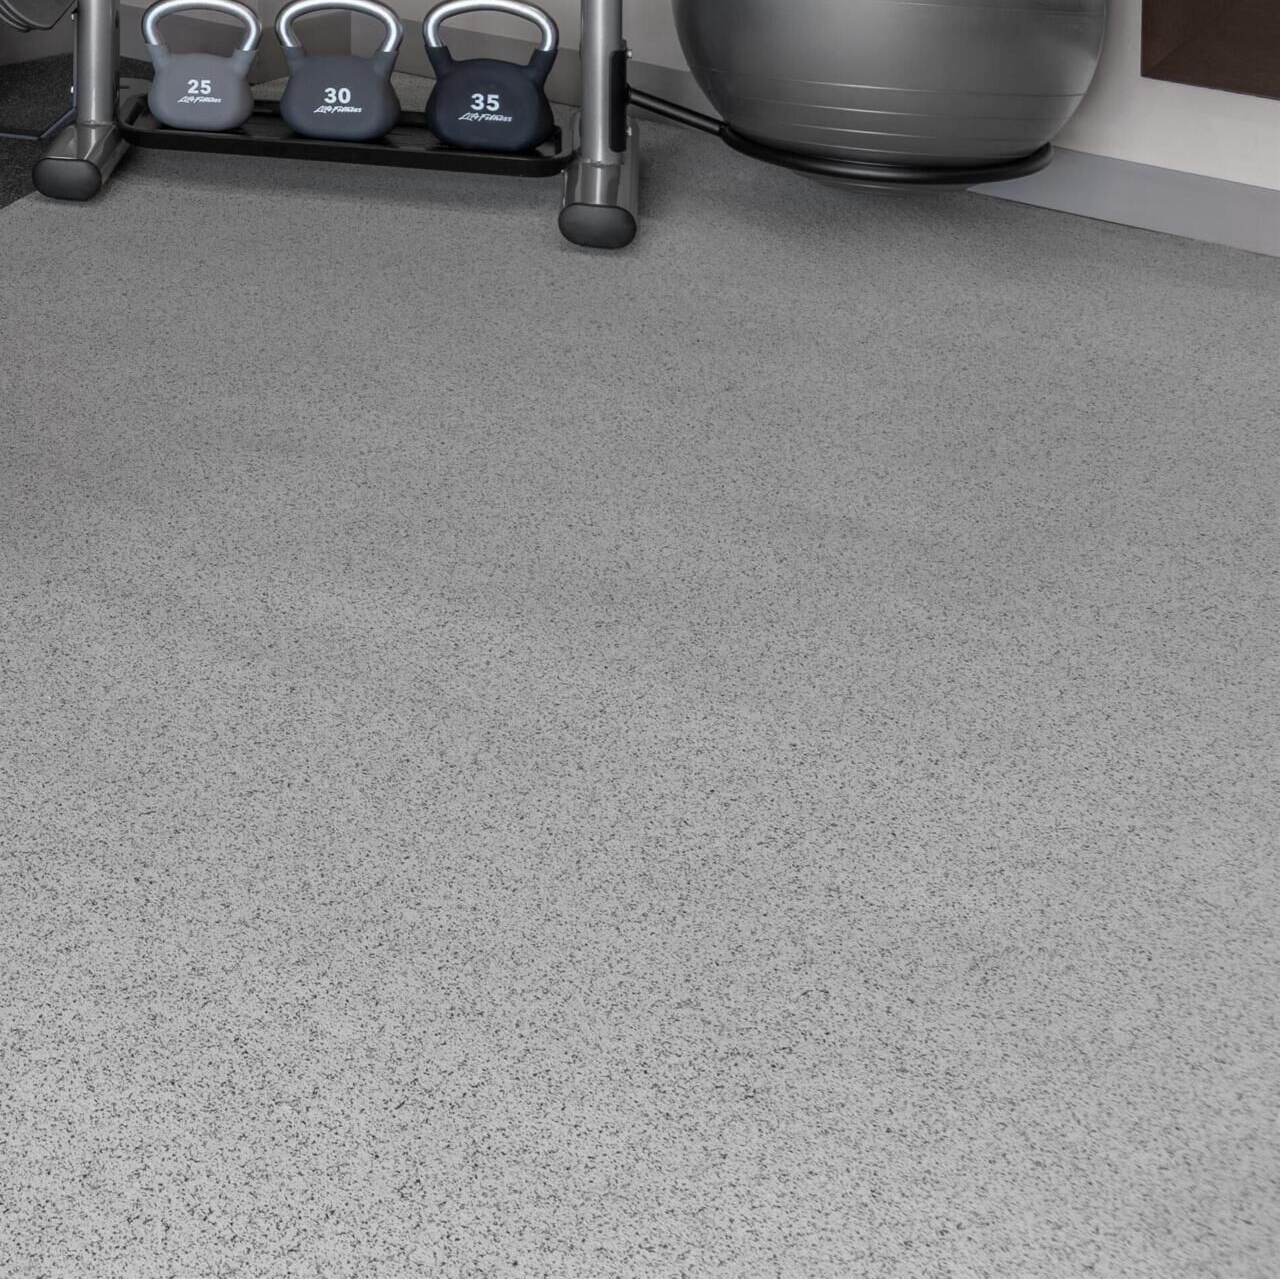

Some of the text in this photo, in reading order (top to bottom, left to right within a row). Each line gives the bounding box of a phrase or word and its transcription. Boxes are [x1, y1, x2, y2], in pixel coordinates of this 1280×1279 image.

[187, 79, 212, 95] 25
[323, 87, 352, 104] 30
[470, 93, 500, 112] 35
